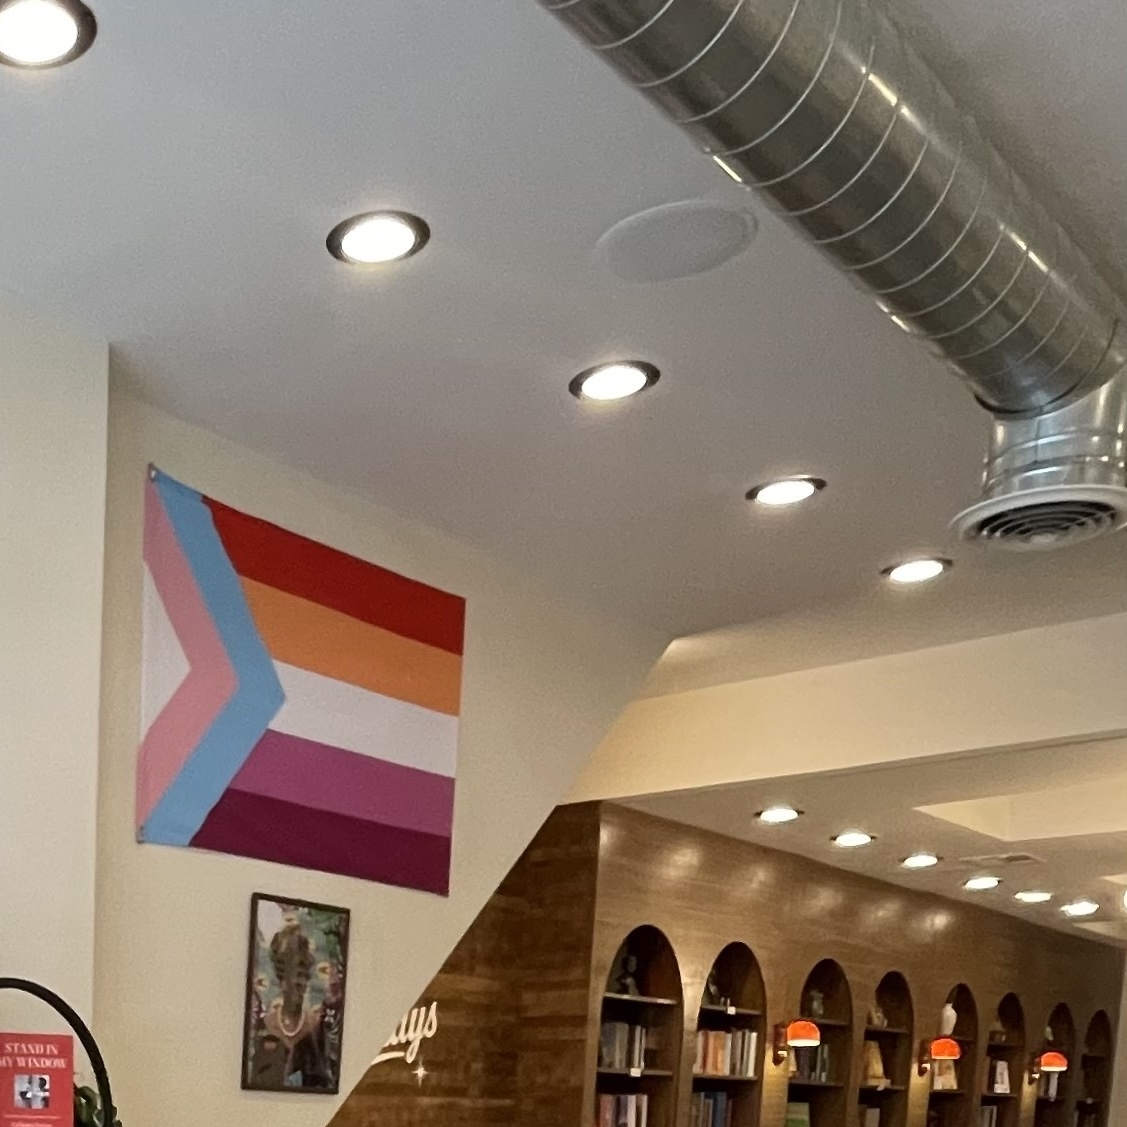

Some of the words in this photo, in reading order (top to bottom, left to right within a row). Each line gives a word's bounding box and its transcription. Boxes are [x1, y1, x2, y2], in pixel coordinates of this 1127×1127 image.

[4, 1042, 45, 1054] STAND
[46, 1043, 59, 1055] IN
[17, 1056, 68, 1069] WINDOW
